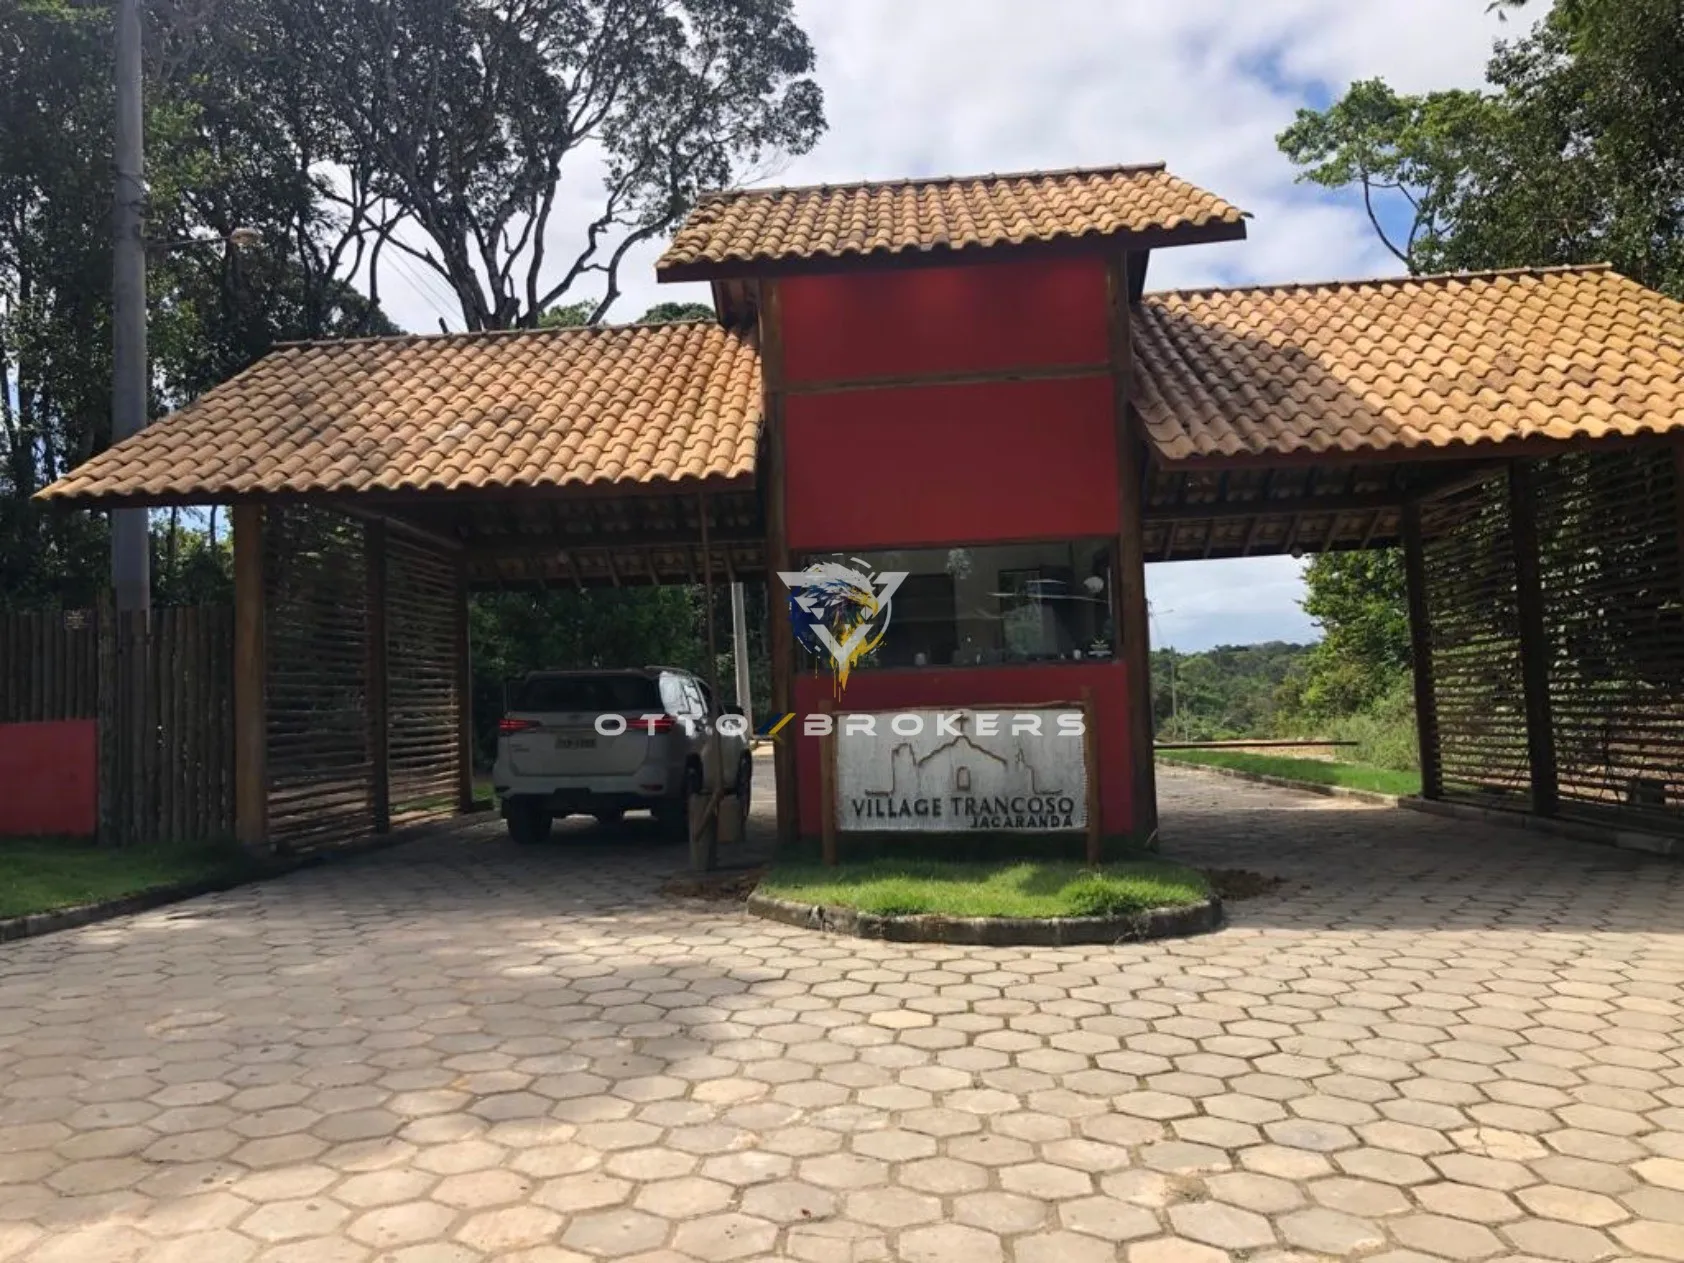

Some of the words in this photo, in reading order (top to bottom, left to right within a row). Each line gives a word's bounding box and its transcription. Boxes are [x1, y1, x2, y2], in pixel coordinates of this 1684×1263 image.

[852, 797, 942, 818] VILLAGE
[951, 796, 1075, 817] TRANCOSO
[970, 814, 1074, 829] JACARANDA
